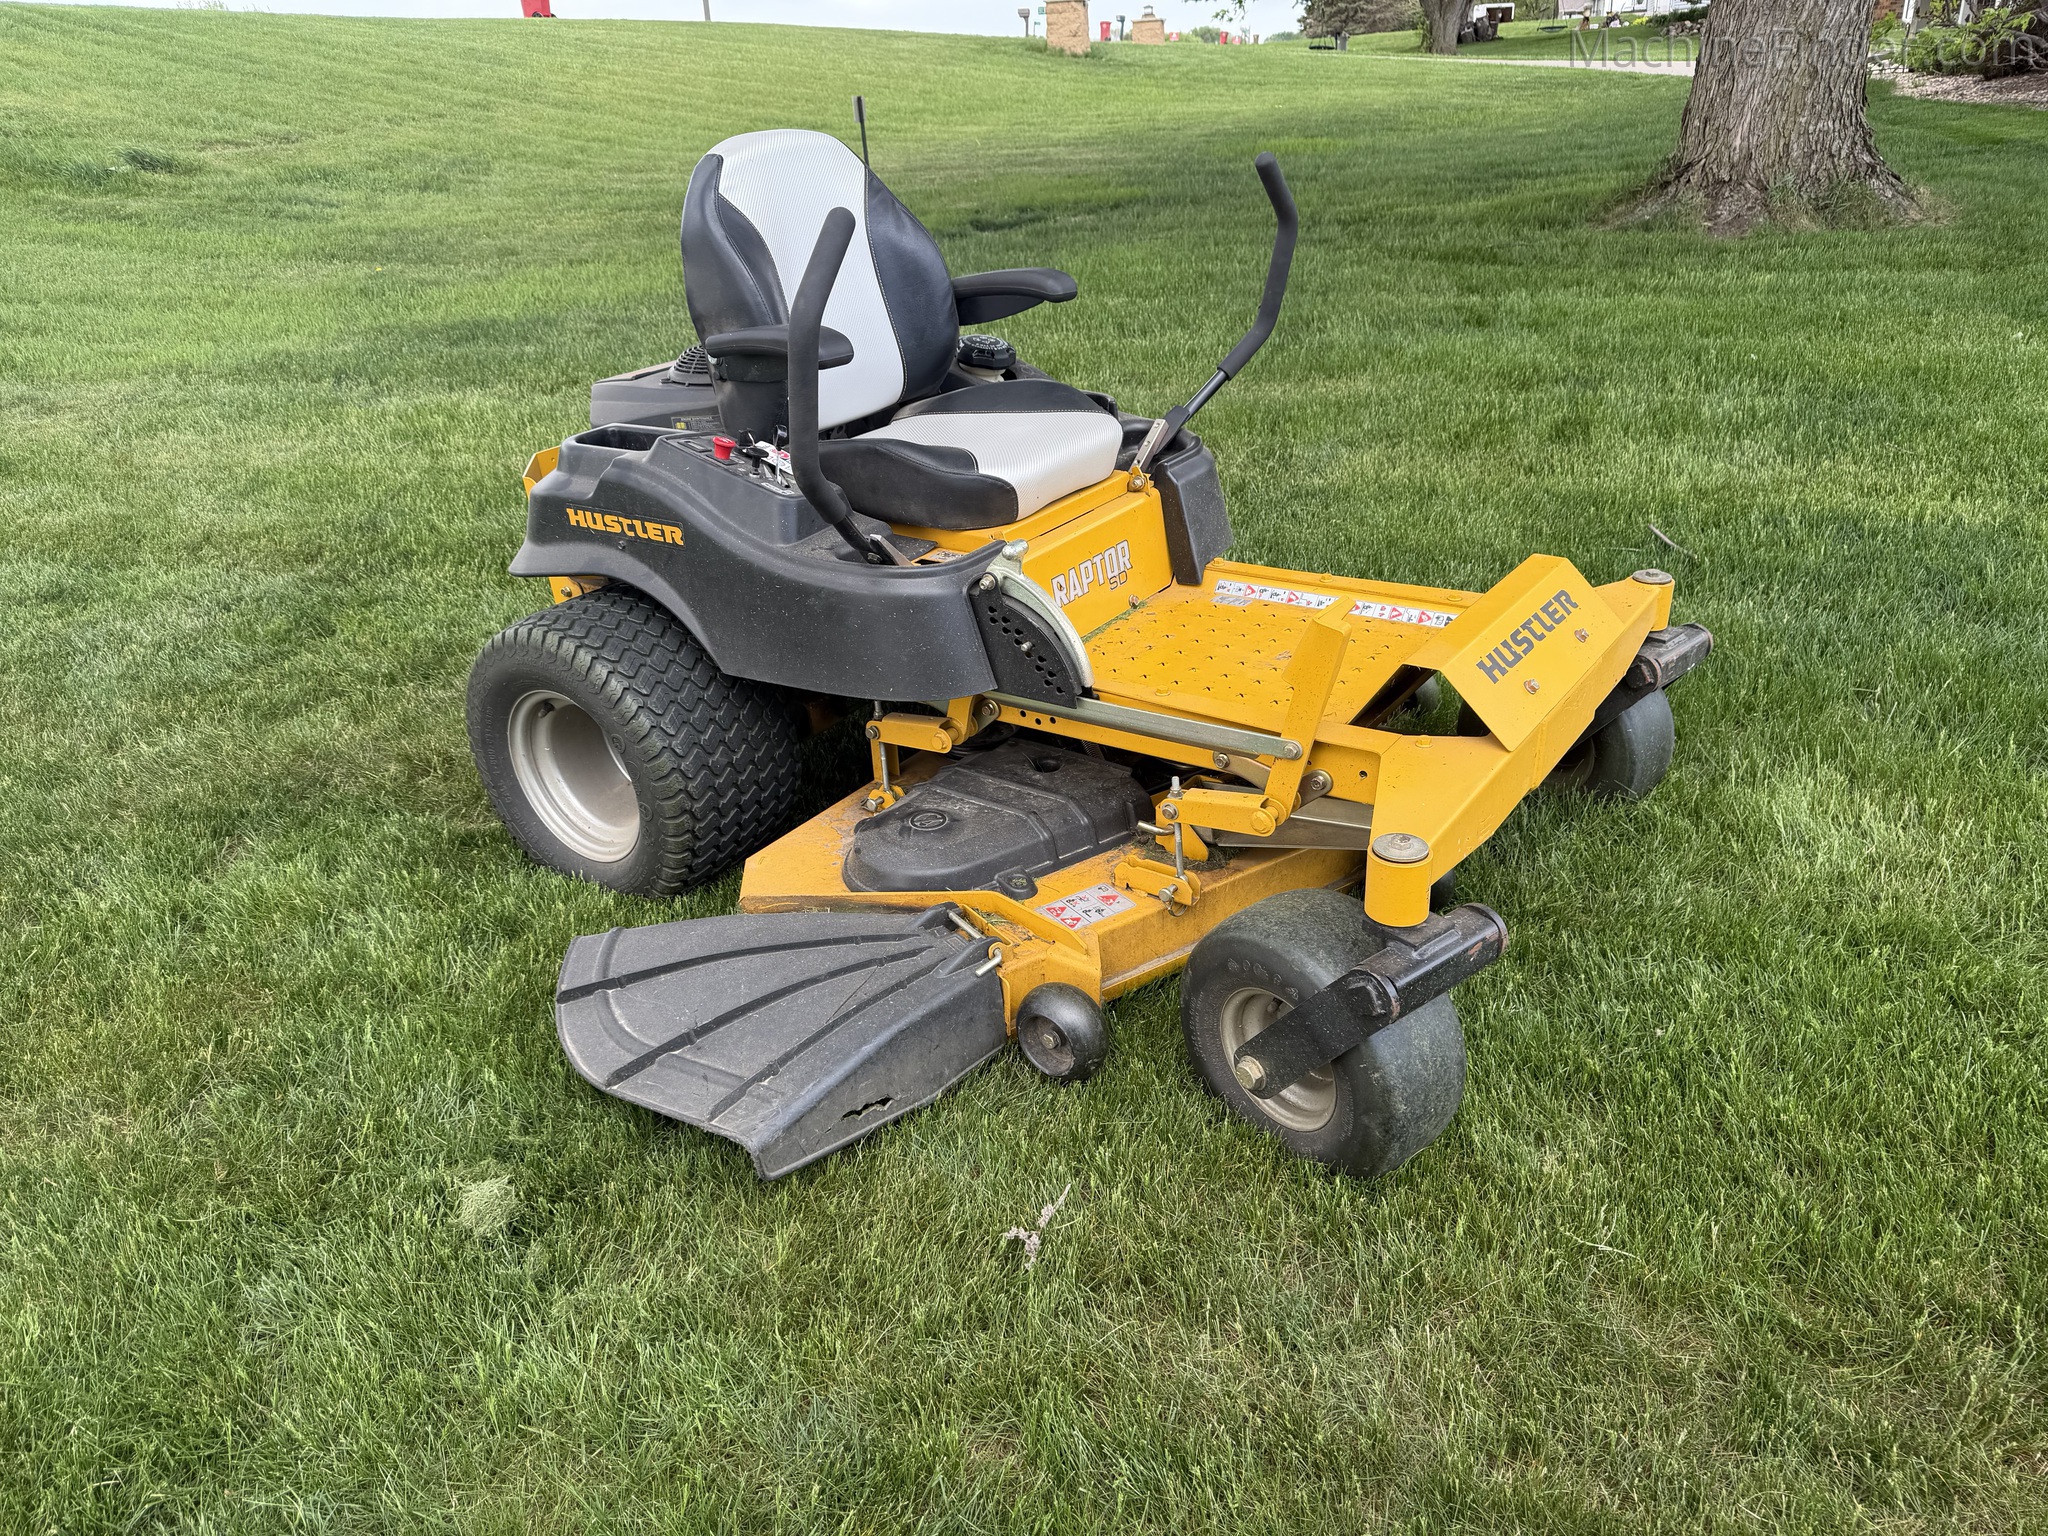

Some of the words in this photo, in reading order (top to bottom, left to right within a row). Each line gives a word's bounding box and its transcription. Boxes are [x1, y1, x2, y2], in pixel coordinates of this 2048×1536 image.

[566, 508, 684, 546] HUSTLER
[1051, 539, 1133, 608] RAPTOR
[1108, 570, 1128, 591] SD
[1475, 589, 1579, 685] HUSTLER
